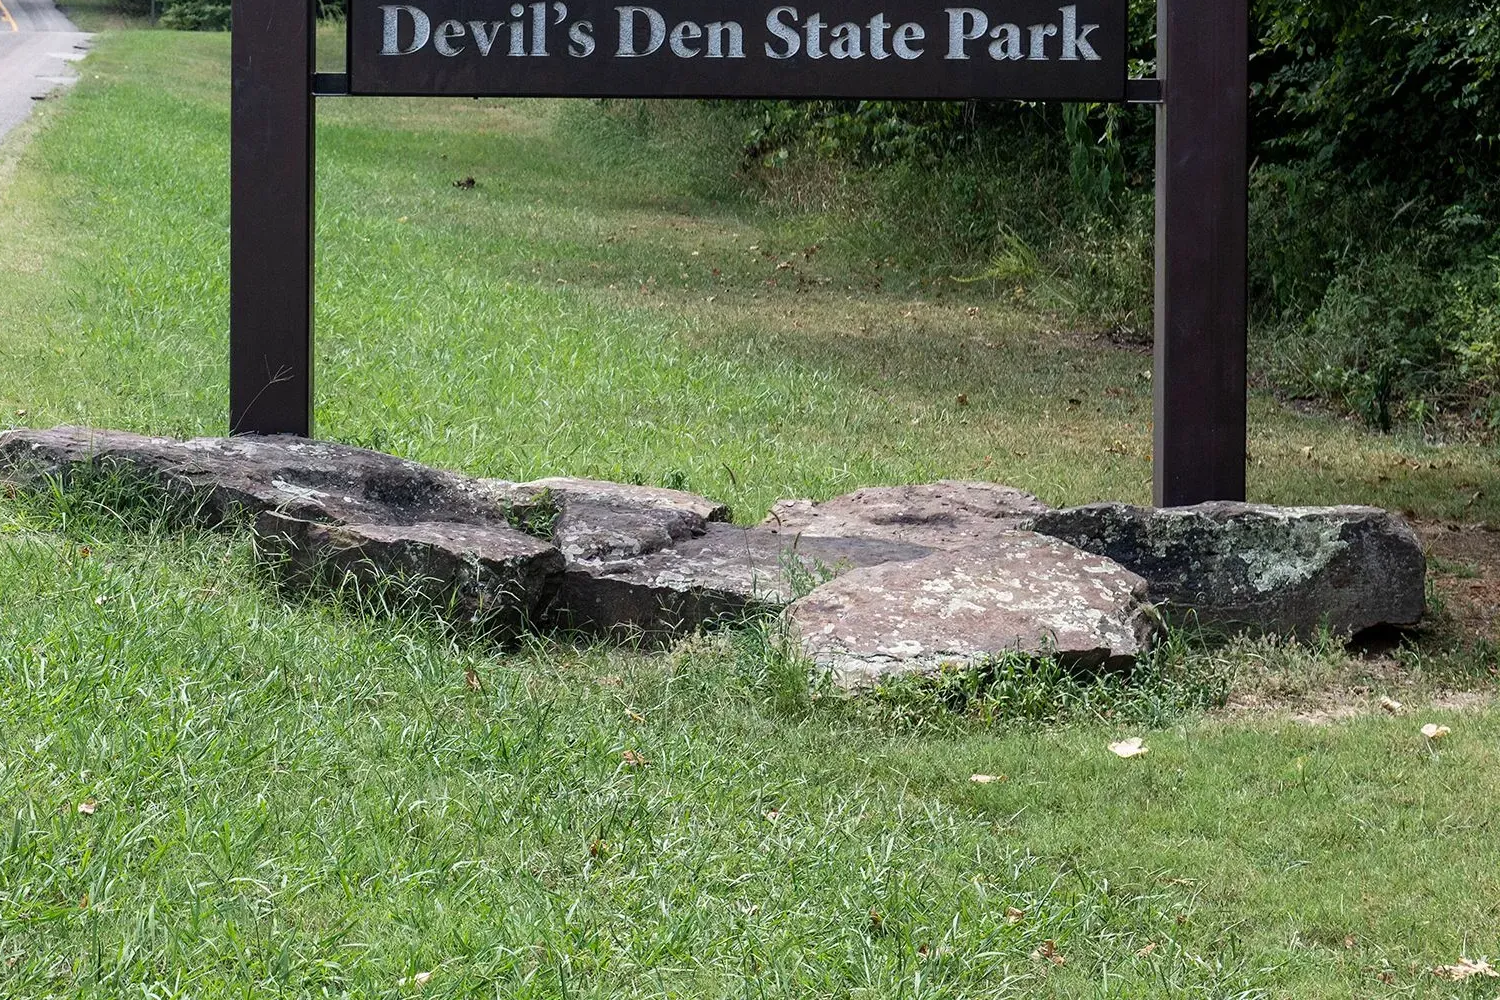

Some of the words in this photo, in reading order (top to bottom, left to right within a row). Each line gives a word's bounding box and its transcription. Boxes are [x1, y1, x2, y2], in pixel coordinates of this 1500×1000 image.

[380, 1, 596, 58] Devil’s
[614, 5, 747, 59] Den
[764, 6, 926, 61] State
[944, 4, 1102, 61] Park
